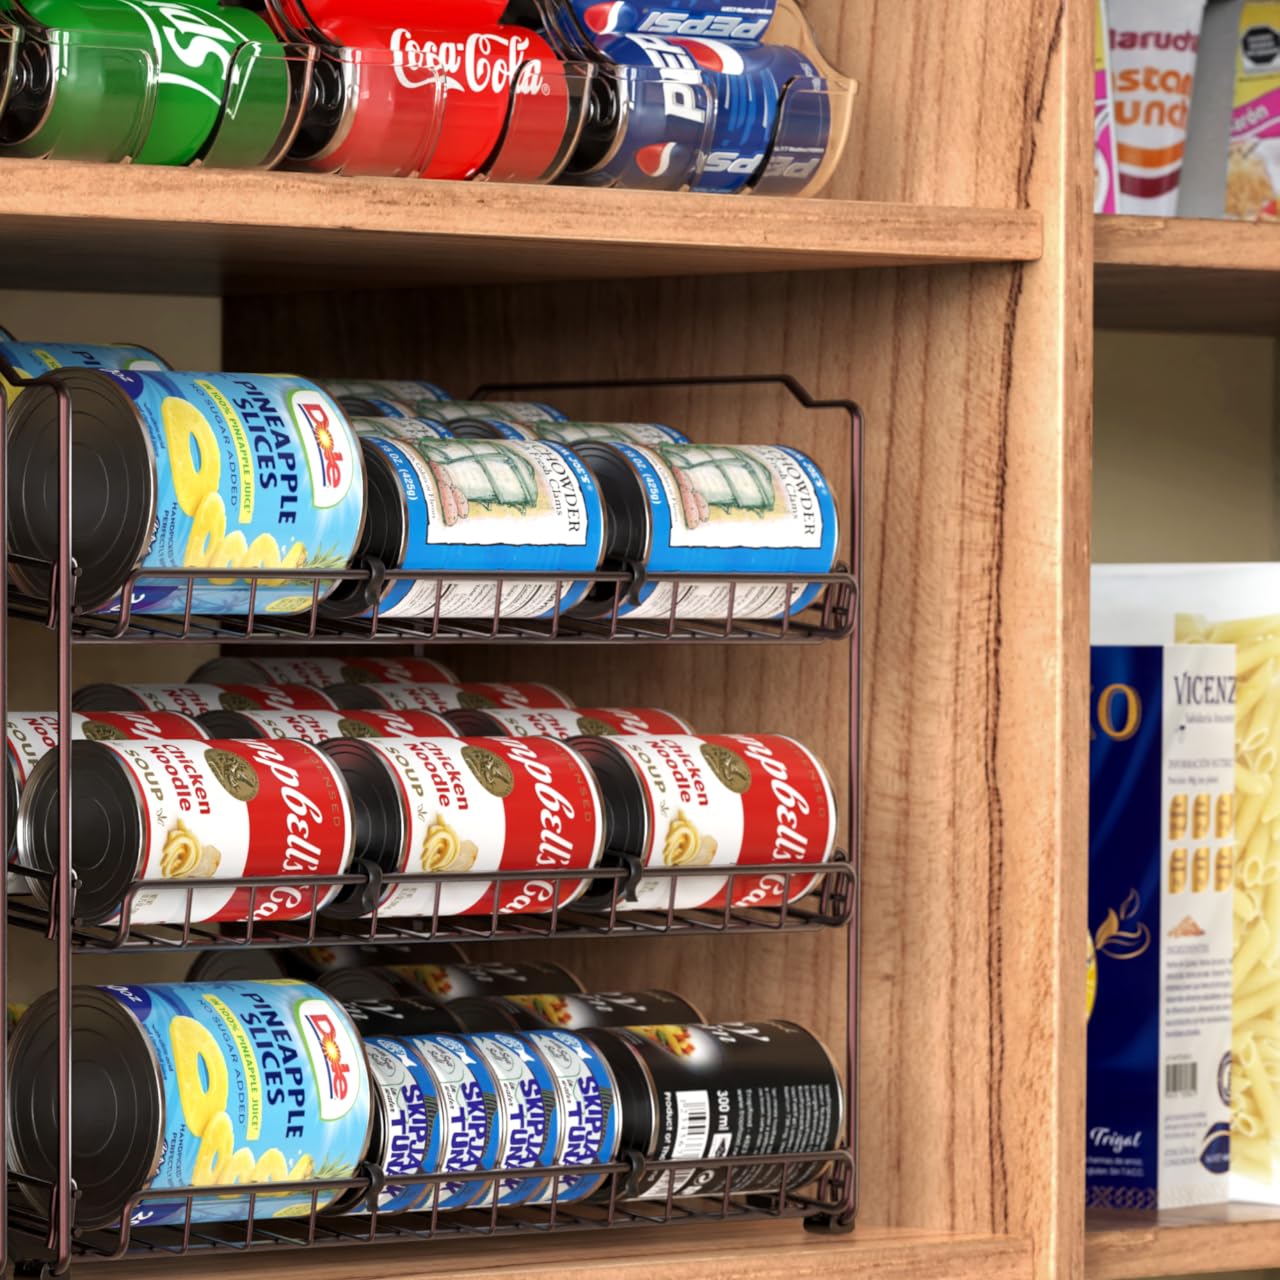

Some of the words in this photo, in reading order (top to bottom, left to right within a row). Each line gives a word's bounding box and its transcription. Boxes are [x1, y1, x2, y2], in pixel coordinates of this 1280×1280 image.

[638, 11, 768, 39] PEPSI
[233, 398, 277, 489] SLICES
[234, 380, 298, 524] PINEAPPLE
[304, 403, 344, 489] Dole
[532, 445, 580, 532] CHOWDER
[125, 748, 164, 801] SOUP
[144, 745, 191, 812] Noodle
[162, 743, 211, 815] Chicken
[385, 747, 424, 797] SOUP
[404, 743, 450, 807] Noodle
[420, 741, 469, 810] Chicken
[629, 744, 666, 793] SOUP
[645, 740, 691, 803] Noodle
[661, 738, 708, 806] Chicken
[241, 1014, 285, 1106] SLICES
[241, 993, 305, 1138] PINEAPPLE
[310, 1014, 350, 1100] Dole
[716, 1090, 730, 1112] 300
